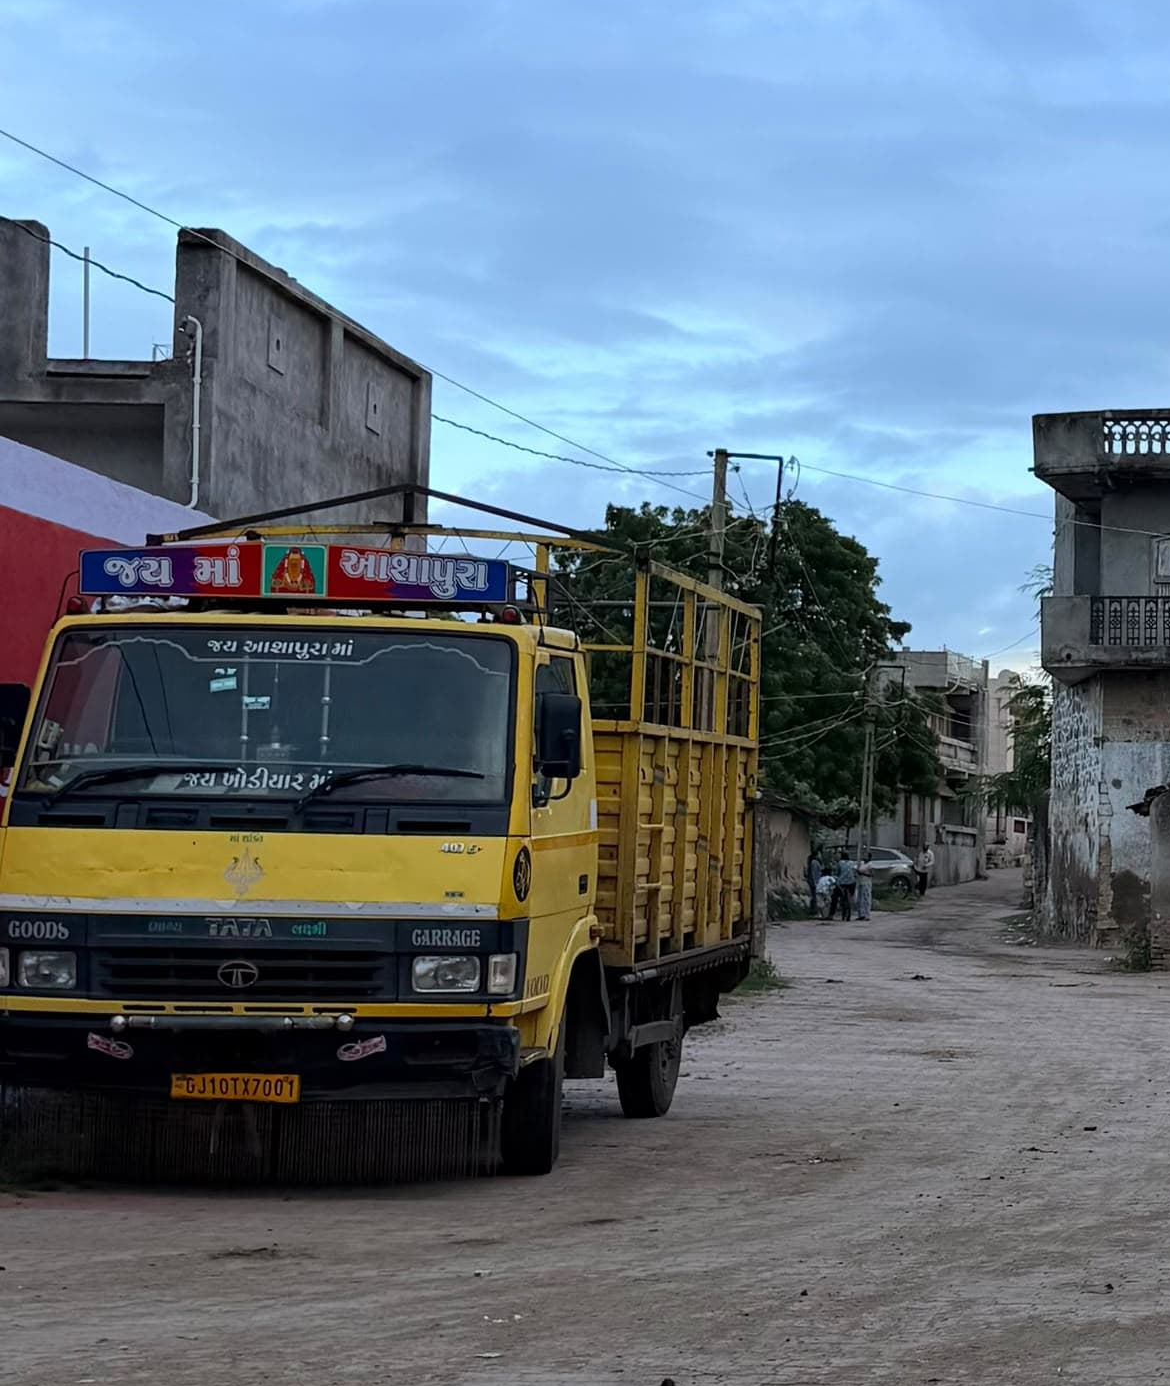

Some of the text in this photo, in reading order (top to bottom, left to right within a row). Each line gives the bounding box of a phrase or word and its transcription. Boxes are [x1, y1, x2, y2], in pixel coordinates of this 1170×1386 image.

[103, 545, 489, 599] જય માં આશાપુરા
[207, 639, 354, 660] જય આશાપુરા માં
[183, 771, 217, 787] જય
[8, 919, 70, 940] GOODS
[204, 917, 273, 937] TATA
[186, 1076, 295, 1098] GJ10TX7001
